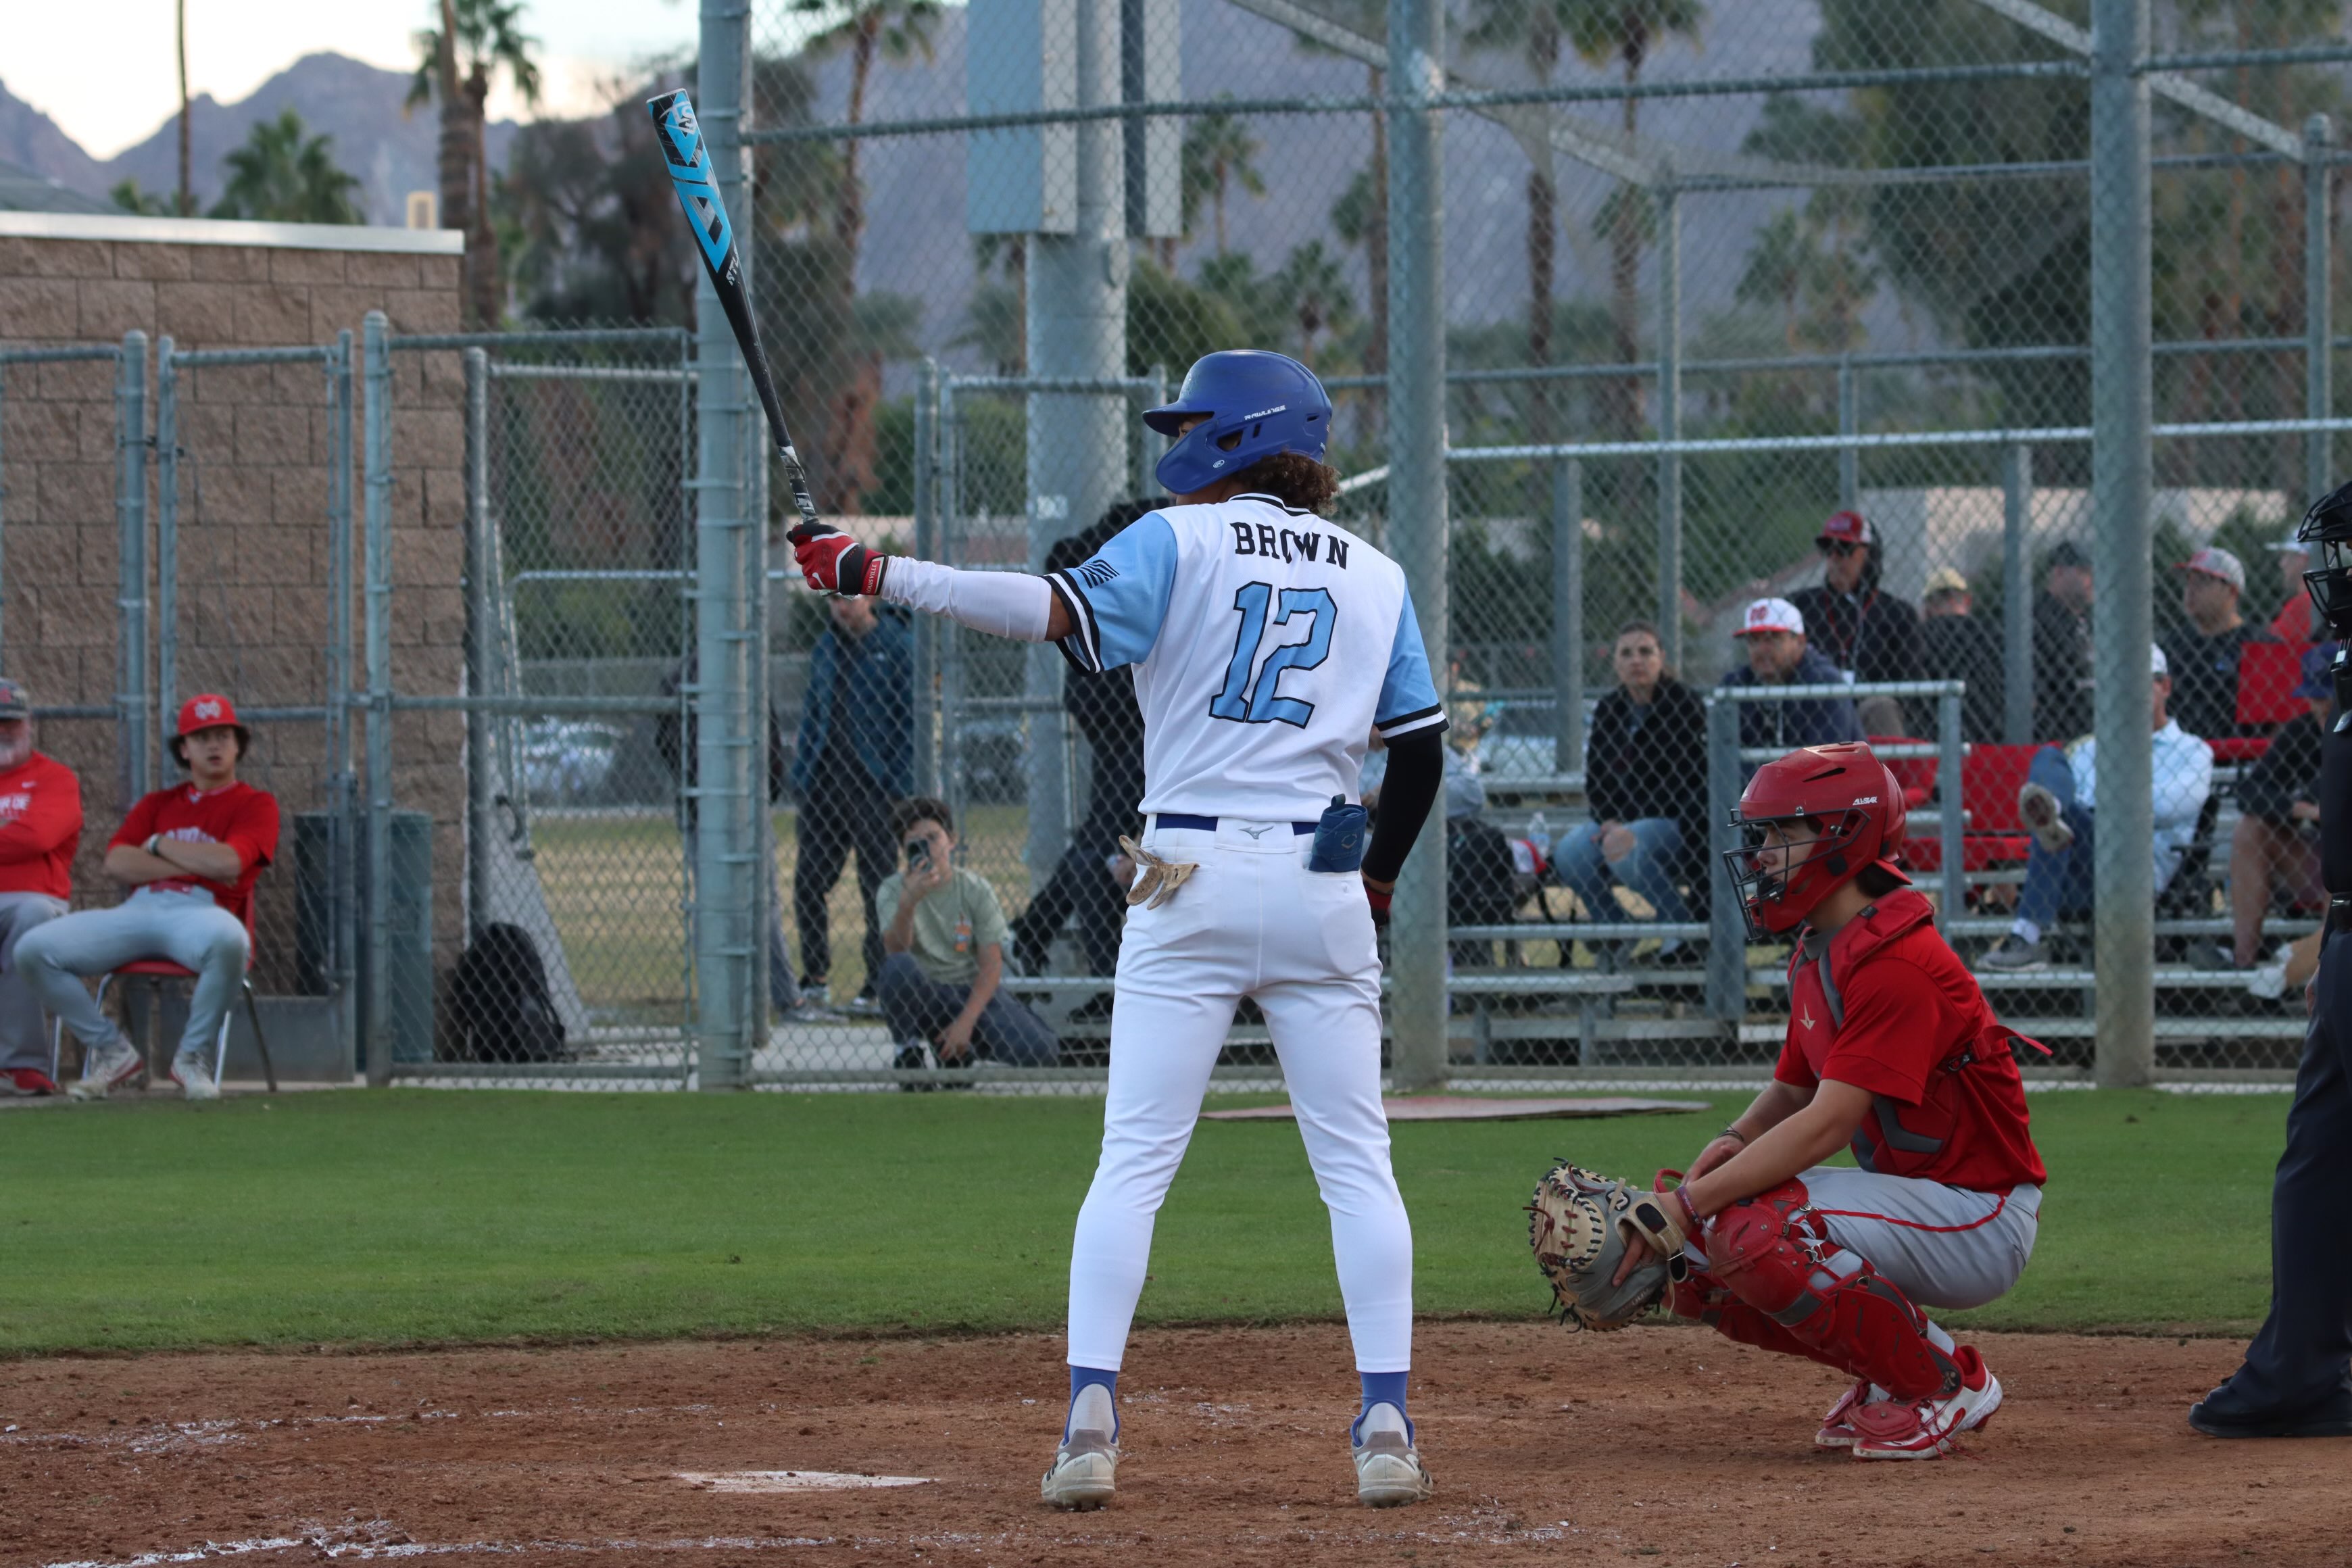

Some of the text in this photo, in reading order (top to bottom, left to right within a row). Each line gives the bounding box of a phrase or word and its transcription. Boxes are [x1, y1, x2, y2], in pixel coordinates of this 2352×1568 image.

[1244, 405, 1286, 420] RAWLINGS
[1230, 522, 1349, 570] BROWN
[866, 564, 877, 593] LOUISVILLE
[1208, 581, 1338, 729] 12
